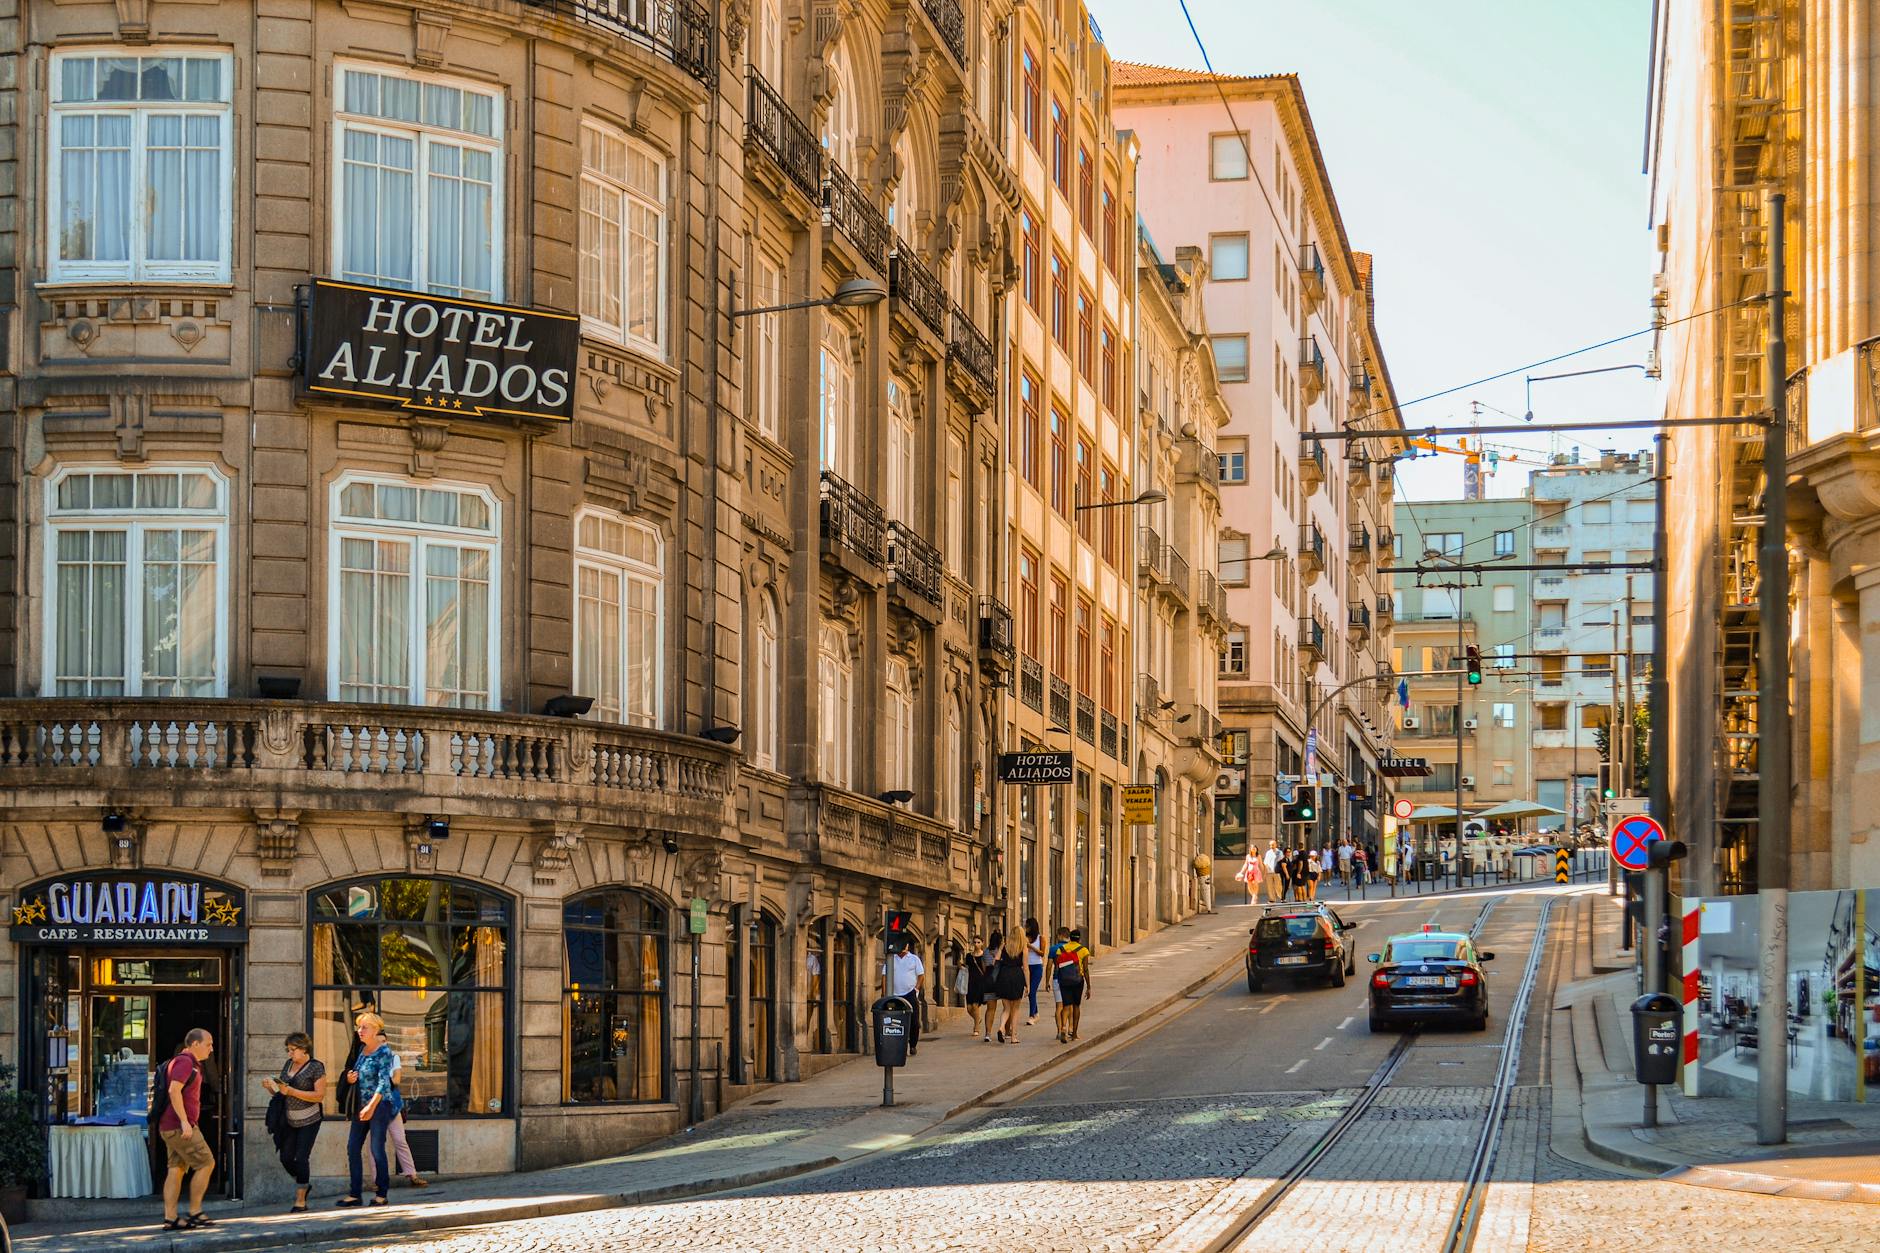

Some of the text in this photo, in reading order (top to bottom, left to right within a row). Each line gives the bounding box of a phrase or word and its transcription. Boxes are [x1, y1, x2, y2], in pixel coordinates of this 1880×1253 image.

[361, 297, 533, 352] HOTEL
[318, 342, 569, 407] ALIADOS
[1016, 755, 1061, 766] HOTEL
[1381, 758, 1421, 768] HOTEL
[1007, 767, 1071, 778] ALIADOS
[118, 840, 128, 848] 89
[420, 845, 428, 854] 91
[49, 881, 200, 924] GUARANY
[94, 928, 208, 940] RESTAURANTE
